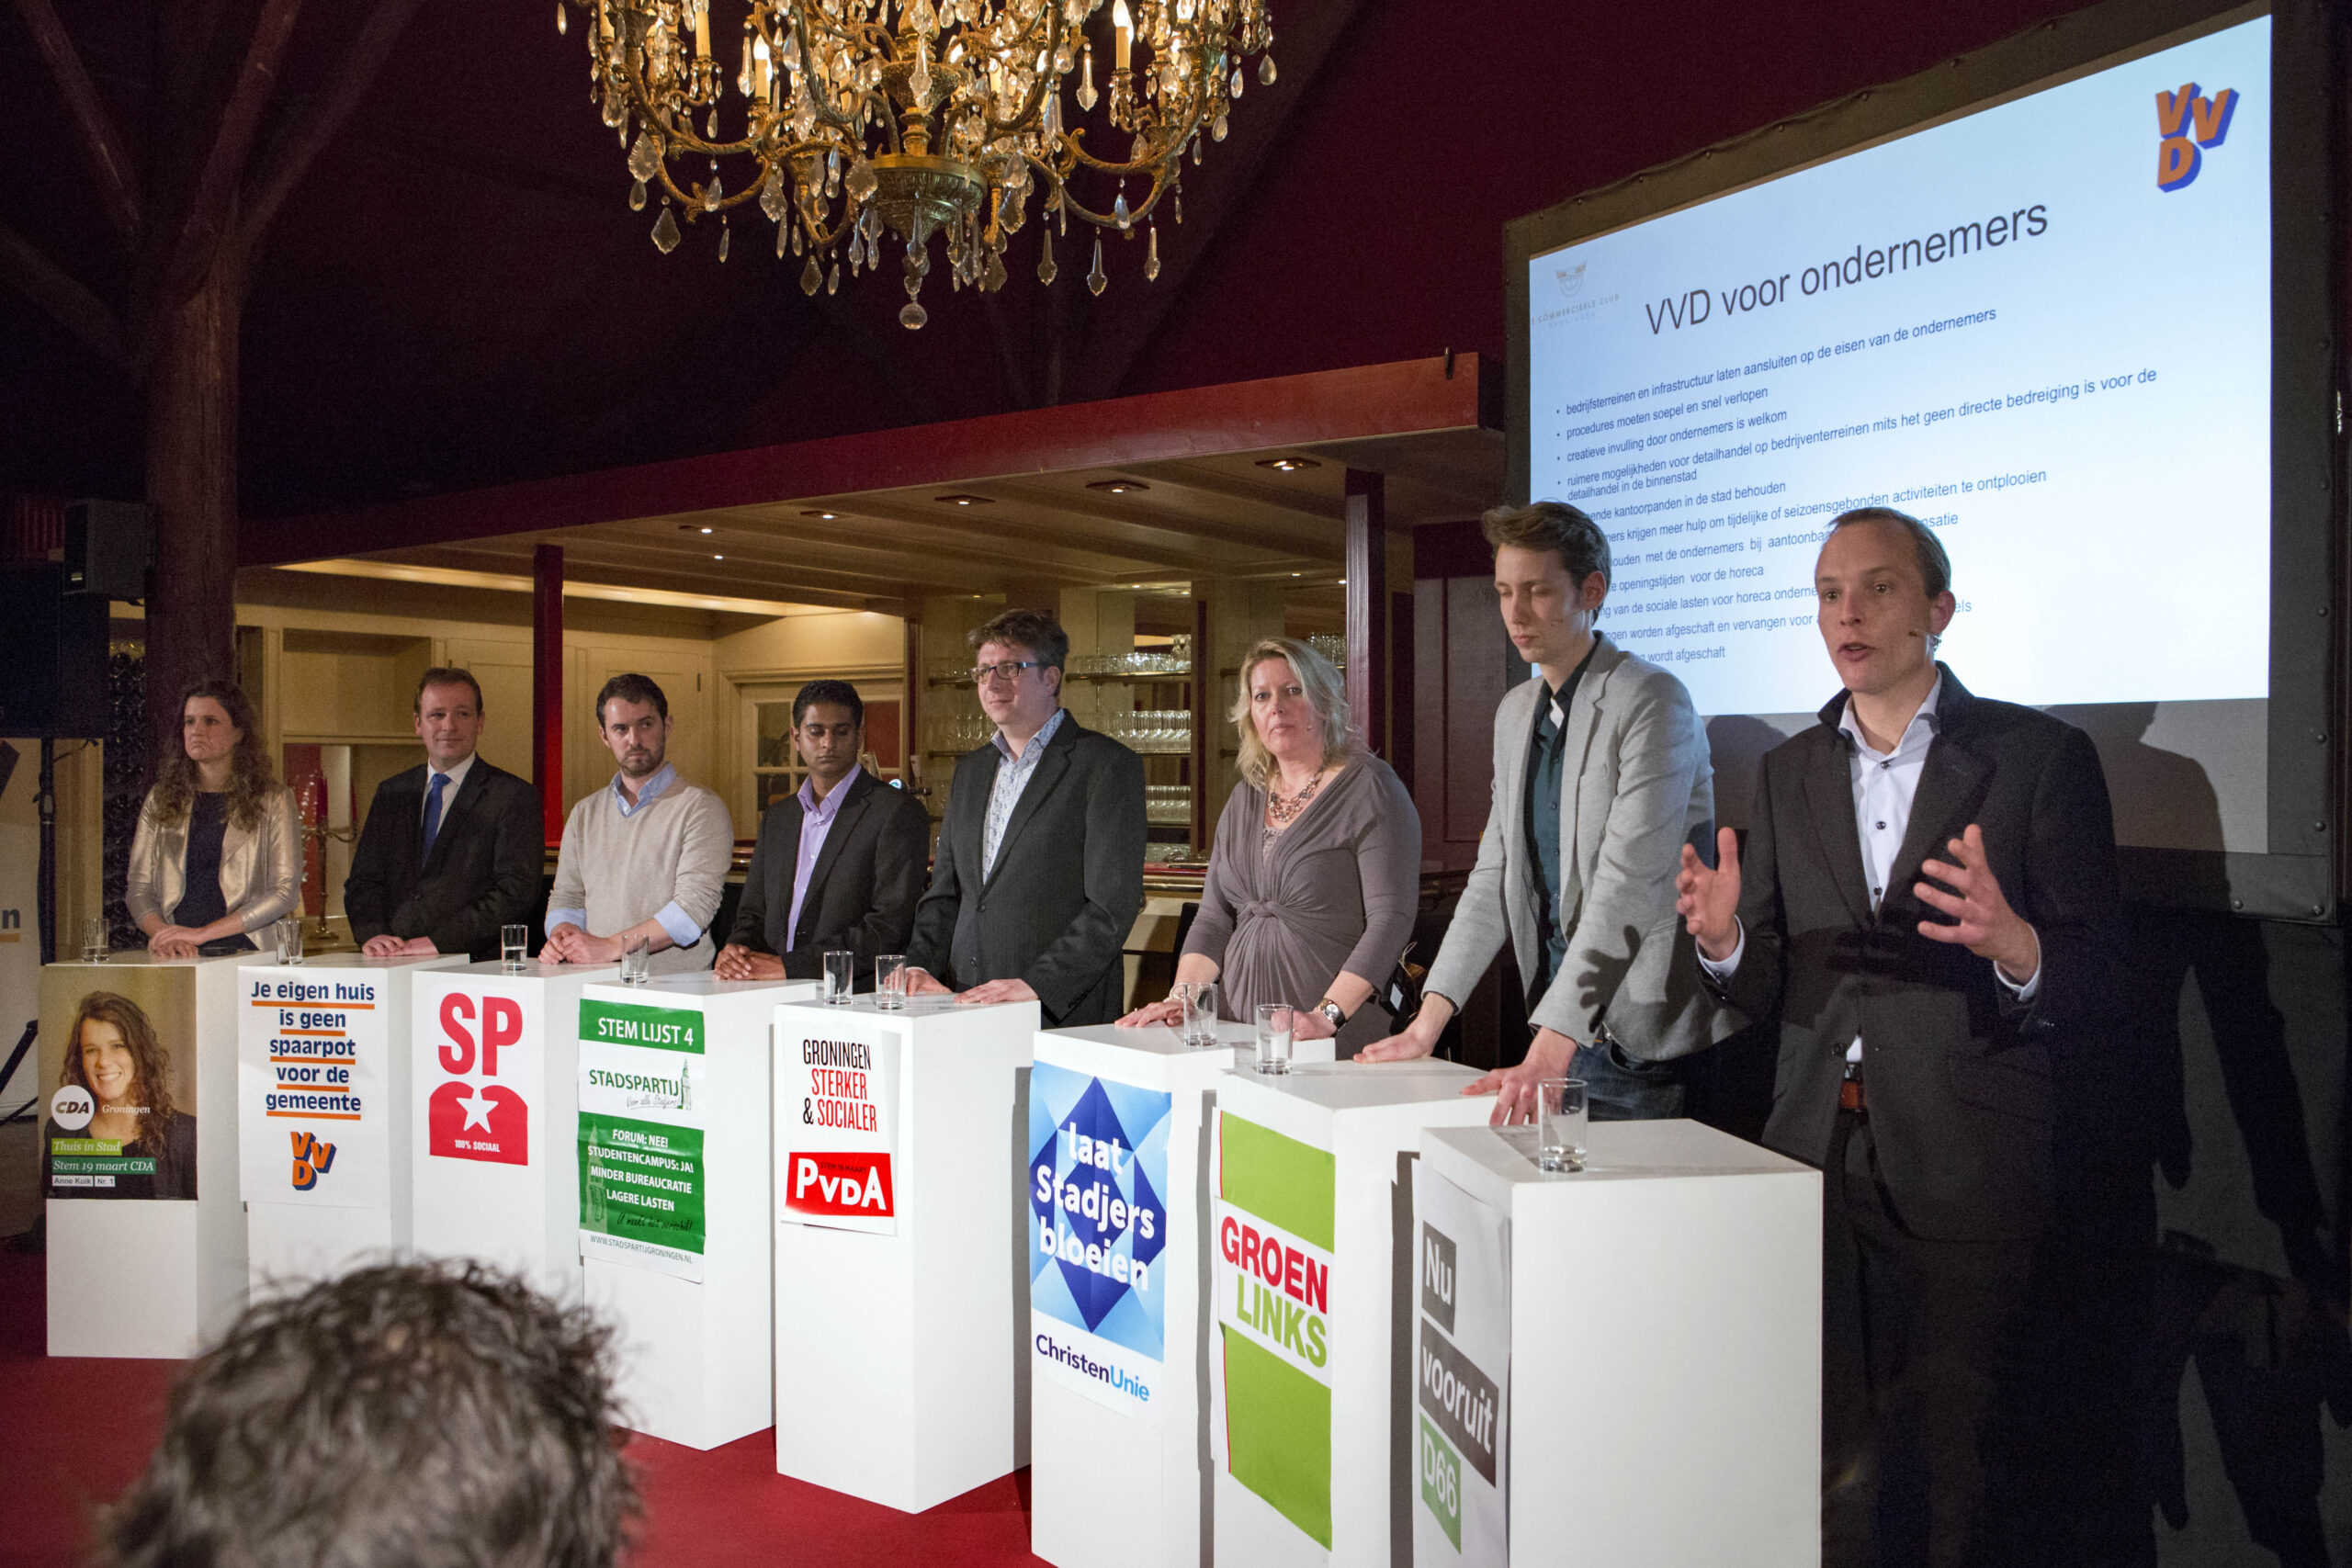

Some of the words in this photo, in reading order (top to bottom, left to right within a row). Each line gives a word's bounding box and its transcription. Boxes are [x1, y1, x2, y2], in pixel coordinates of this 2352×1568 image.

[2154, 82, 2240, 193] VVD
[1645, 289, 1711, 334] VVD
[1722, 274, 1791, 315] voor
[1802, 205, 2048, 295] ondernemers
[1566, 392, 1635, 415] bedrijfsterreinen
[1638, 389, 1649, 399] en
[1652, 374, 1713, 396] infrastructuur
[1717, 367, 1741, 381] laten
[1744, 355, 1797, 375] aansluiten
[1801, 351, 1814, 365] op
[1817, 346, 1831, 358] de
[1835, 340, 1865, 355] eisen
[1869, 333, 1890, 346] van
[1894, 328, 1908, 342] de
[1913, 310, 1996, 337] ondernemers
[1567, 421, 1614, 441] procedures
[1617, 413, 1650, 428] moeten
[1653, 403, 1683, 420] soepel
[1686, 402, 1698, 413] en
[1702, 395, 1722, 410] snel
[1724, 388, 1768, 405] verlopen
[1567, 473, 1600, 488] ruimere
[1602, 460, 1667, 481] mogelijkheden
[1669, 457, 1690, 468] voor
[1692, 442, 1752, 464] detailhandel
[1755, 443, 1768, 455] op
[1771, 423, 1869, 450] bedrijventerreinen
[1873, 417, 1897, 432] mits
[1902, 412, 1920, 426] het
[1924, 408, 1954, 426] geen
[1959, 398, 2002, 416] directe
[2007, 385, 2079, 407] bedreiging
[2085, 379, 2095, 393] is
[2100, 375, 2133, 389] voor
[2138, 368, 2156, 383] de
[1567, 446, 1605, 462] creatieve
[1608, 439, 1644, 454] invulling
[1646, 434, 1668, 446] door
[1669, 422, 1734, 442] ondernemers
[1736, 418, 1745, 429] is
[1747, 412, 1787, 426] welkom
[1567, 482, 1619, 501] detailhandel
[1622, 481, 1630, 492] in
[1632, 479, 1644, 490] de
[1646, 468, 1697, 488] binnenstad
[1614, 498, 1682, 517] kantoorpanden
[1685, 495, 1693, 507] in
[1696, 493, 1708, 505] de
[1711, 489, 1732, 502] stad
[1735, 482, 1786, 499] behouden
[1627, 527, 1657, 541] krijgen
[1660, 524, 1683, 536] meer
[1686, 518, 1707, 533] hulp
[1709, 518, 1724, 528] om
[1727, 510, 1768, 528] tijdelijke
[1771, 507, 1781, 520] of
[1784, 493, 1889, 518] seizoensgebonden
[1893, 484, 1957, 502] activiteiten
[1962, 480, 1973, 492] te
[1977, 470, 2046, 491] ontplooien
[1645, 551, 1663, 562] met
[1666, 548, 1678, 560] de
[1679, 542, 1744, 558] ondernemers
[1750, 536, 1761, 552] bij
[1619, 573, 1684, 592] openingstijden
[1690, 572, 1712, 582] voor
[1713, 569, 1726, 581] de
[1729, 566, 1764, 579] horeca
[1613, 605, 1629, 615] van
[1632, 603, 1644, 614] de
[1645, 599, 1678, 612] sociale
[1680, 597, 1709, 609] lasten
[1712, 595, 1734, 605] voor
[1736, 592, 1771, 603] horeca
[1630, 626, 1663, 638] worden
[1666, 621, 1714, 638] afgeschaft
[1717, 622, 1730, 632] en
[1733, 617, 1786, 631] vervangen
[1790, 615, 1813, 626] voor
[1648, 649, 1673, 662] wordt
[1676, 646, 1725, 663] afgeschaft
[251, 981, 271, 998] Je
[277, 982, 329, 1001] eigen
[335, 983, 375, 1000] huis
[279, 1009, 294, 1025] is
[300, 1013, 346, 1028] geen
[598, 1018, 638, 1039] STEM
[642, 1021, 681, 1044] LIJST
[684, 1028, 694, 1046] 4
[270, 1039, 356, 1057] spaarpot
[438, 992, 523, 1077] SP
[803, 1039, 871, 1070] GRONINGEN
[277, 1066, 320, 1082] voor
[326, 1066, 349, 1083] de
[589, 1069, 679, 1096] STADSPARTIJ
[812, 1068, 867, 1100] STERKER
[55, 1101, 89, 1114] CDA
[102, 1104, 151, 1116] Groningen
[266, 1093, 361, 1111] gemeente
[803, 1098, 814, 1124] &
[818, 1100, 876, 1133] SOCIALER
[53, 1140, 82, 1152] Thuis
[84, 1141, 94, 1152] in
[96, 1141, 120, 1153] Stad
[473, 1141, 500, 1153] SOCIAAL
[613, 1129, 647, 1145] FORUM:
[649, 1134, 669, 1148] NEE!
[1069, 1122, 1123, 1175] laat
[53, 1160, 79, 1171] Stem
[81, 1162, 93, 1173] 19
[96, 1161, 128, 1172] maart
[130, 1162, 153, 1172] CDA
[290, 1132, 337, 1190] VVD
[588, 1145, 679, 1170] STUDENTENCAMPUS:
[680, 1160, 694, 1173] JA!
[54, 1177, 74, 1185] Anne
[75, 1177, 92, 1185] Kuik
[97, 1177, 107, 1185] Nr.
[591, 1166, 624, 1181] MINDER
[626, 1172, 692, 1194] BUREAUCRATIE
[606, 1189, 639, 1205] LAGERE
[641, 1195, 674, 1212] LASTEN
[1036, 1164, 1154, 1239] Stadjers
[590, 1235, 693, 1263] WWW.STADSPARTIJGRONINGEN.NL
[1039, 1215, 1148, 1292] bloeien
[1221, 1215, 1328, 1315] GROEN
[1426, 1236, 1452, 1305] Nu
[1237, 1273, 1328, 1368] LINKS
[1035, 1333, 1149, 1402] ChristenUnie
[1422, 1346, 1493, 1455] vooruit
[1424, 1430, 1457, 1518] D66
